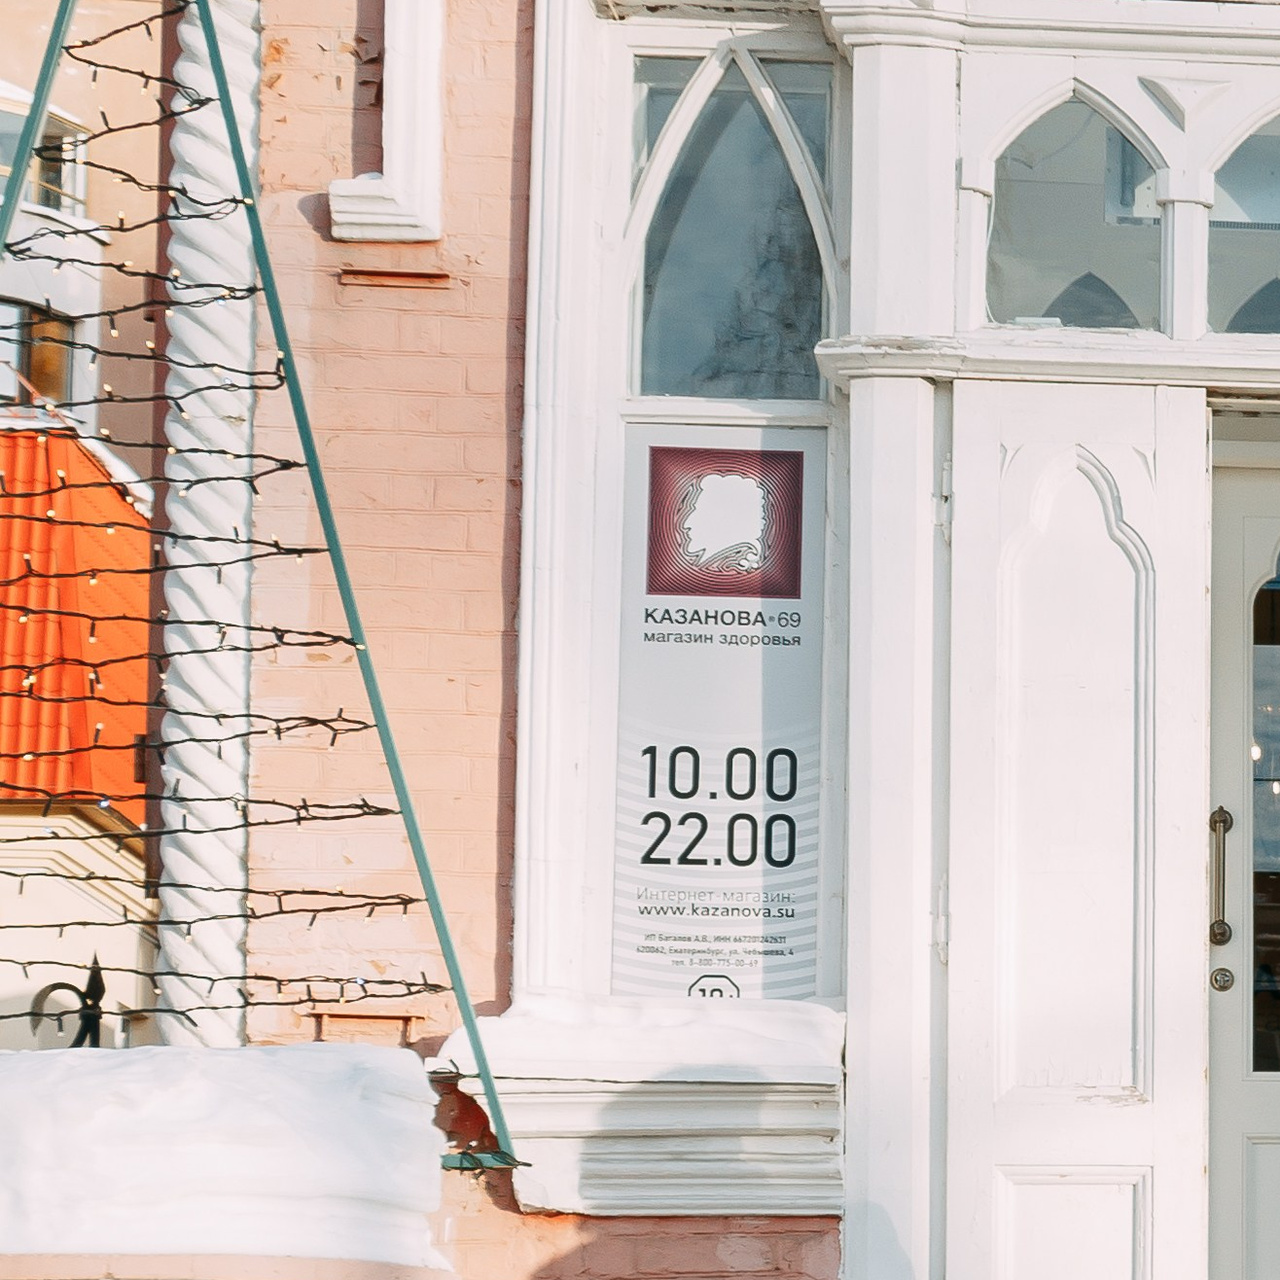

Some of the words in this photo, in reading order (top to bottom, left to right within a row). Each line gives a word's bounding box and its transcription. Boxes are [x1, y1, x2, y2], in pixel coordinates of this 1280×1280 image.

[644, 607, 767, 627] КАЗАНОВА
[777, 611, 801, 628] 69
[643, 631, 713, 644] магазин
[719, 633, 801, 647] здоровья
[640, 745, 798, 803] 10.00
[640, 811, 797, 869] 22.00
[638, 903, 796, 919] www.kazanova.su
